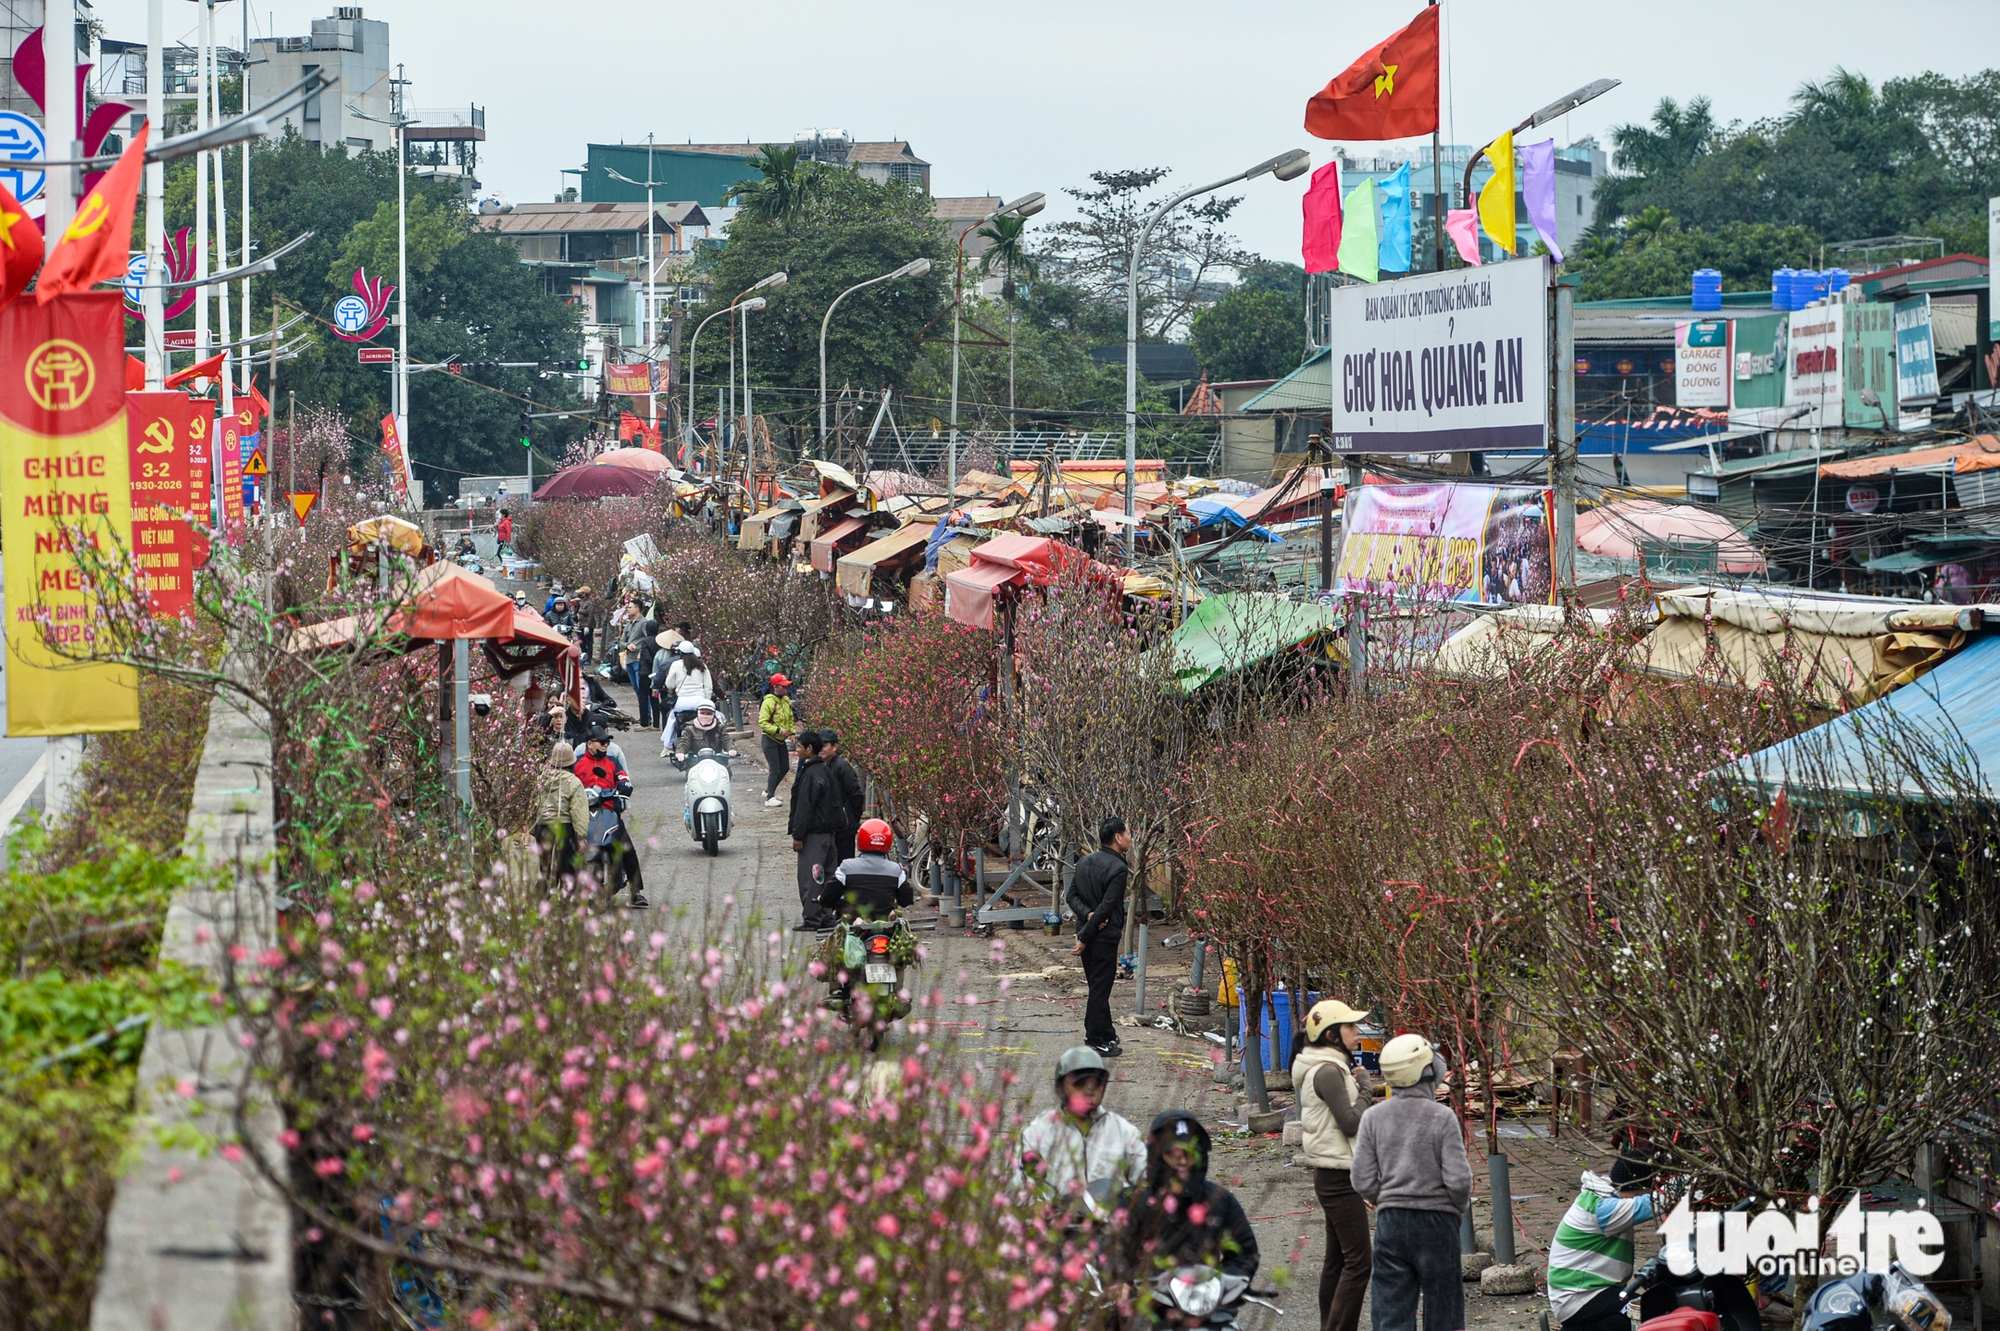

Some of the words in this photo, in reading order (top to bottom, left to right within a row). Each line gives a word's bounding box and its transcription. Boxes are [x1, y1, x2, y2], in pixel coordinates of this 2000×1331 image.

[1365, 297, 1379, 321] BAN
[1380, 287, 1399, 323] QUẢN
[1408, 289, 1424, 322] CHỢ
[1424, 283, 1454, 315] PHƯỜNG
[1480, 274, 1492, 307] HÀ
[1681, 349, 1722, 359] GARAGE
[1343, 347, 1376, 426] CHỢ
[1380, 350, 1417, 413] HOA
[1421, 316, 1487, 418] QUẢNG
[1494, 337, 1524, 404] AN
[24, 450, 106, 480] CHÚC
[142, 462, 170, 478] 3-2
[130, 480, 182, 490] 1930-2026
[23, 489, 110, 517] MỪNG
[141, 527, 156, 548] VIỆT
[157, 529, 174, 545] NAM
[137, 553, 161, 570] QUANG
[162, 553, 179, 568] VINH
[159, 573, 176, 591] NĂM
